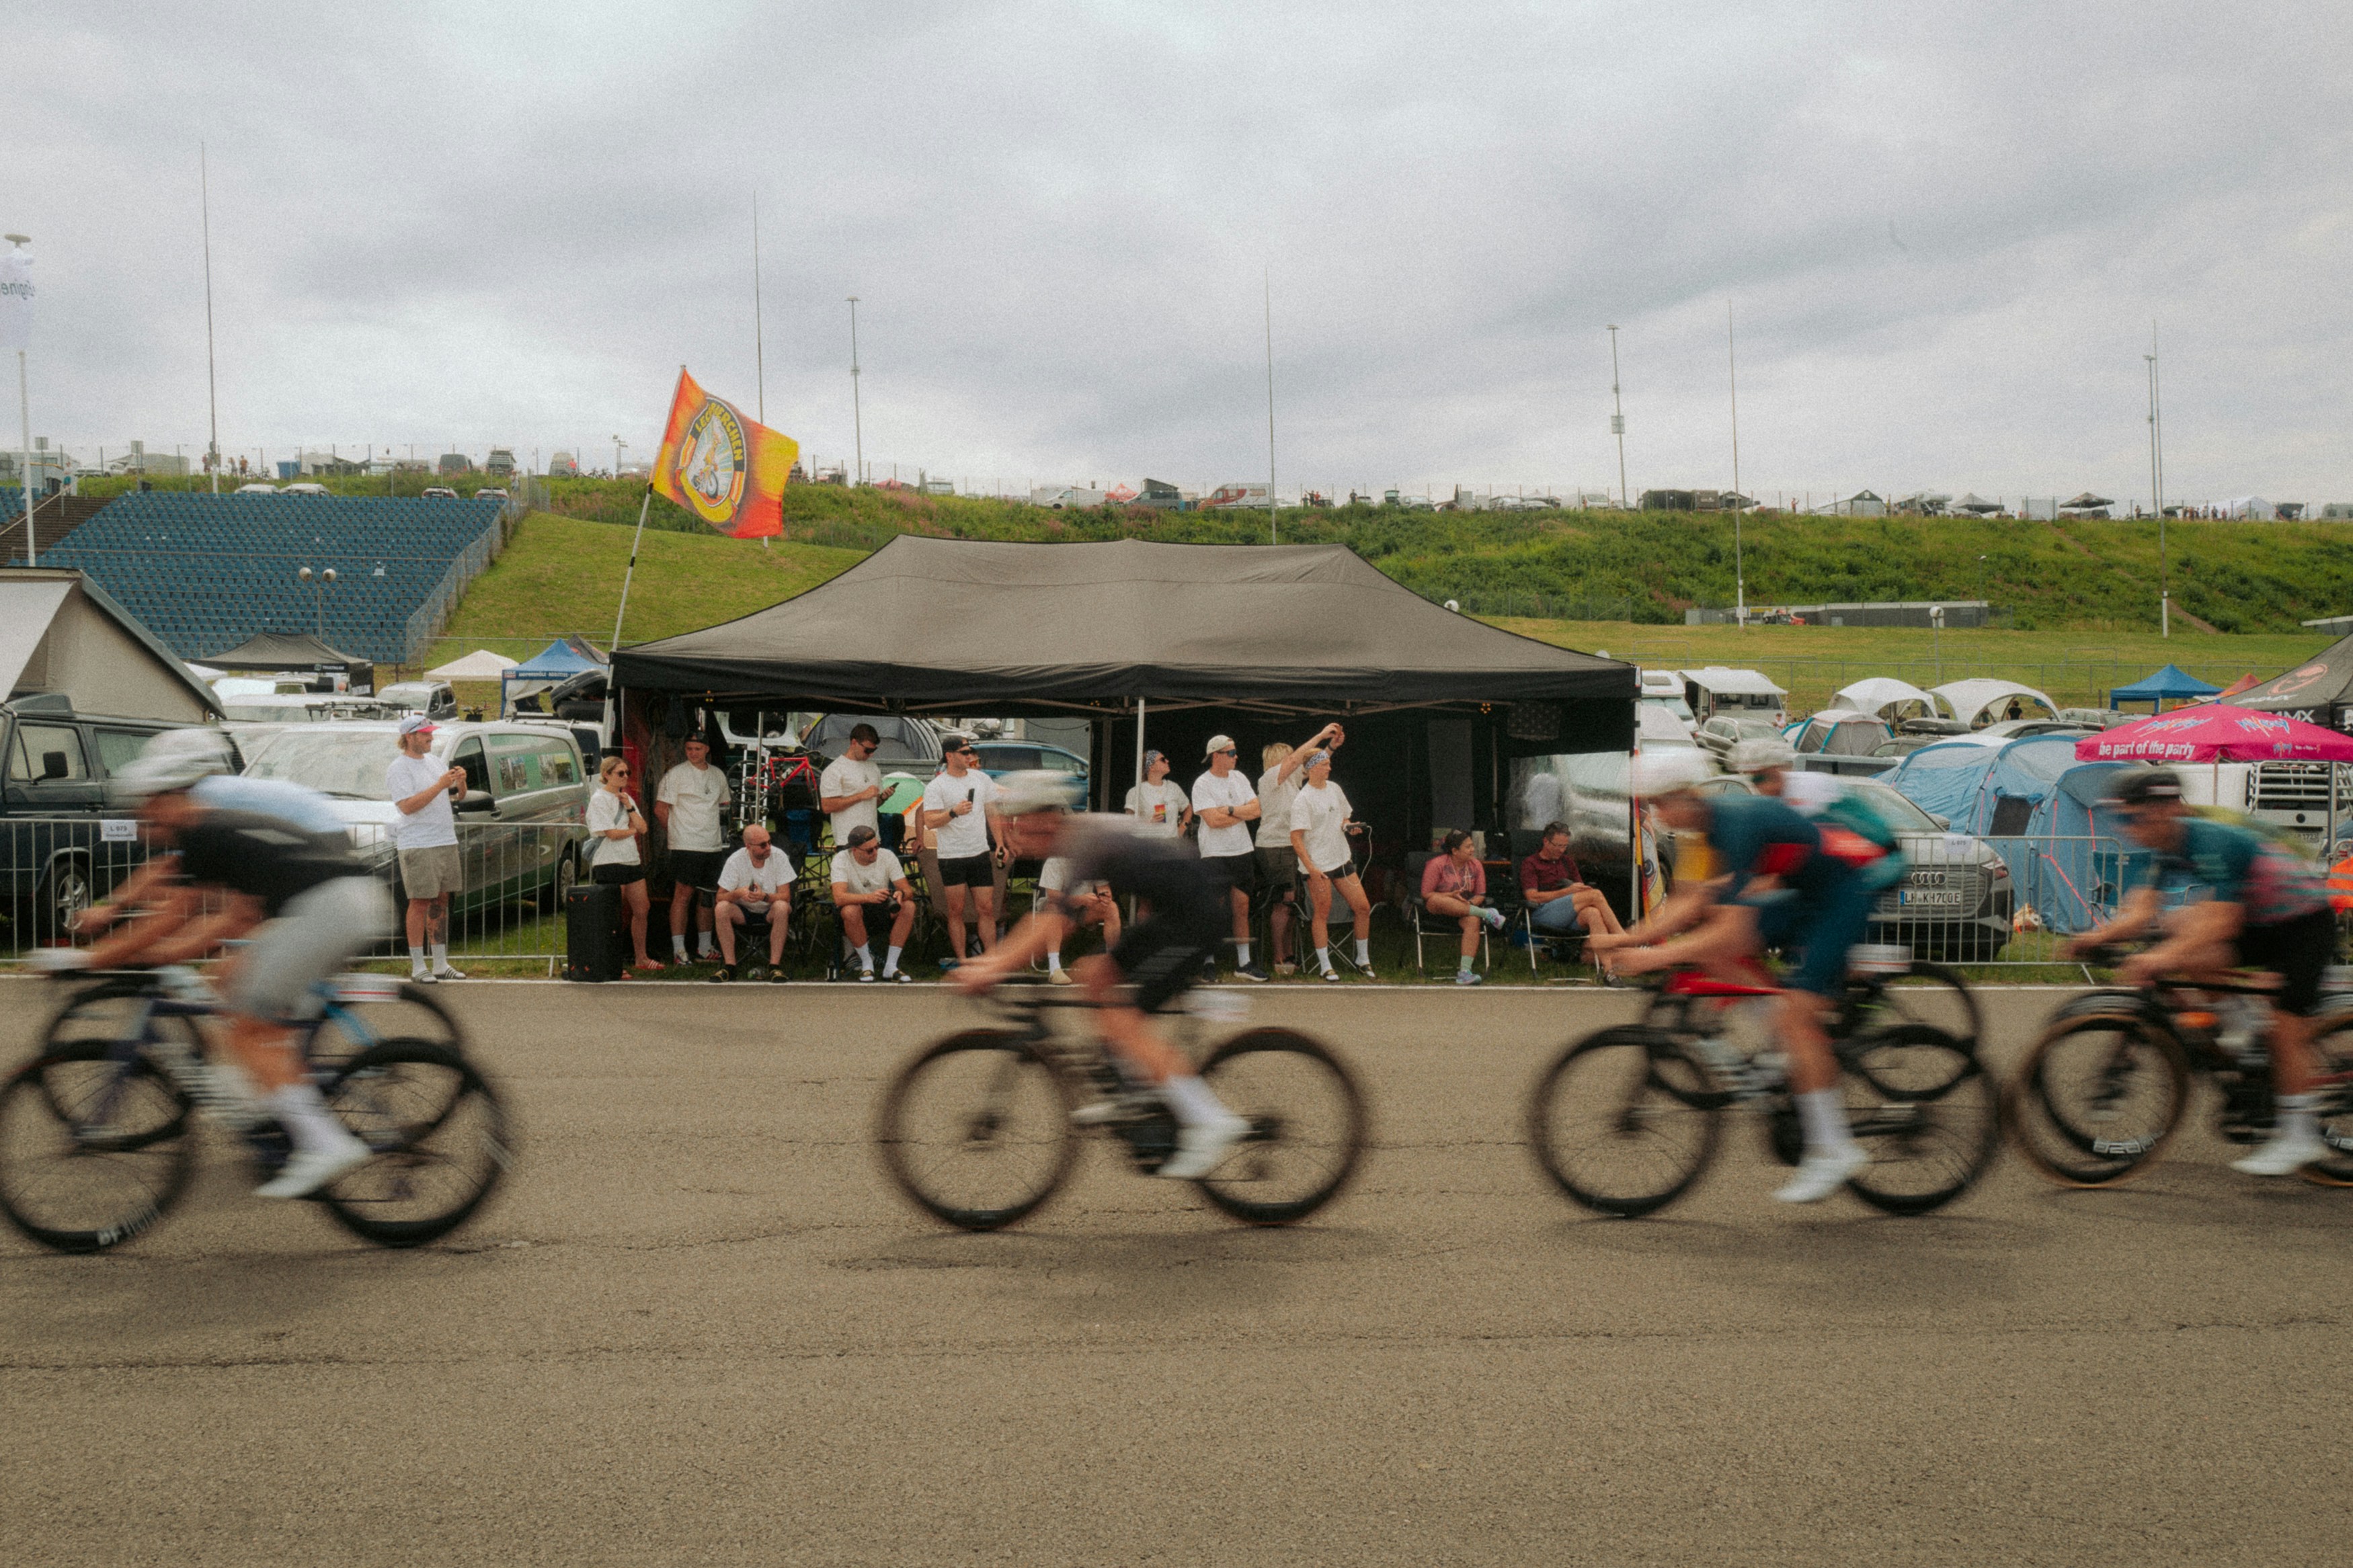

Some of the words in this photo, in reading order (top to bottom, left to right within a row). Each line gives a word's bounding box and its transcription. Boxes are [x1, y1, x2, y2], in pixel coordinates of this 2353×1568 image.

[2099, 741, 2112, 755] be
[2113, 741, 2135, 758] part
[2136, 741, 2149, 755] of
[2149, 740, 2165, 754] the
[2165, 742, 2195, 759] party
